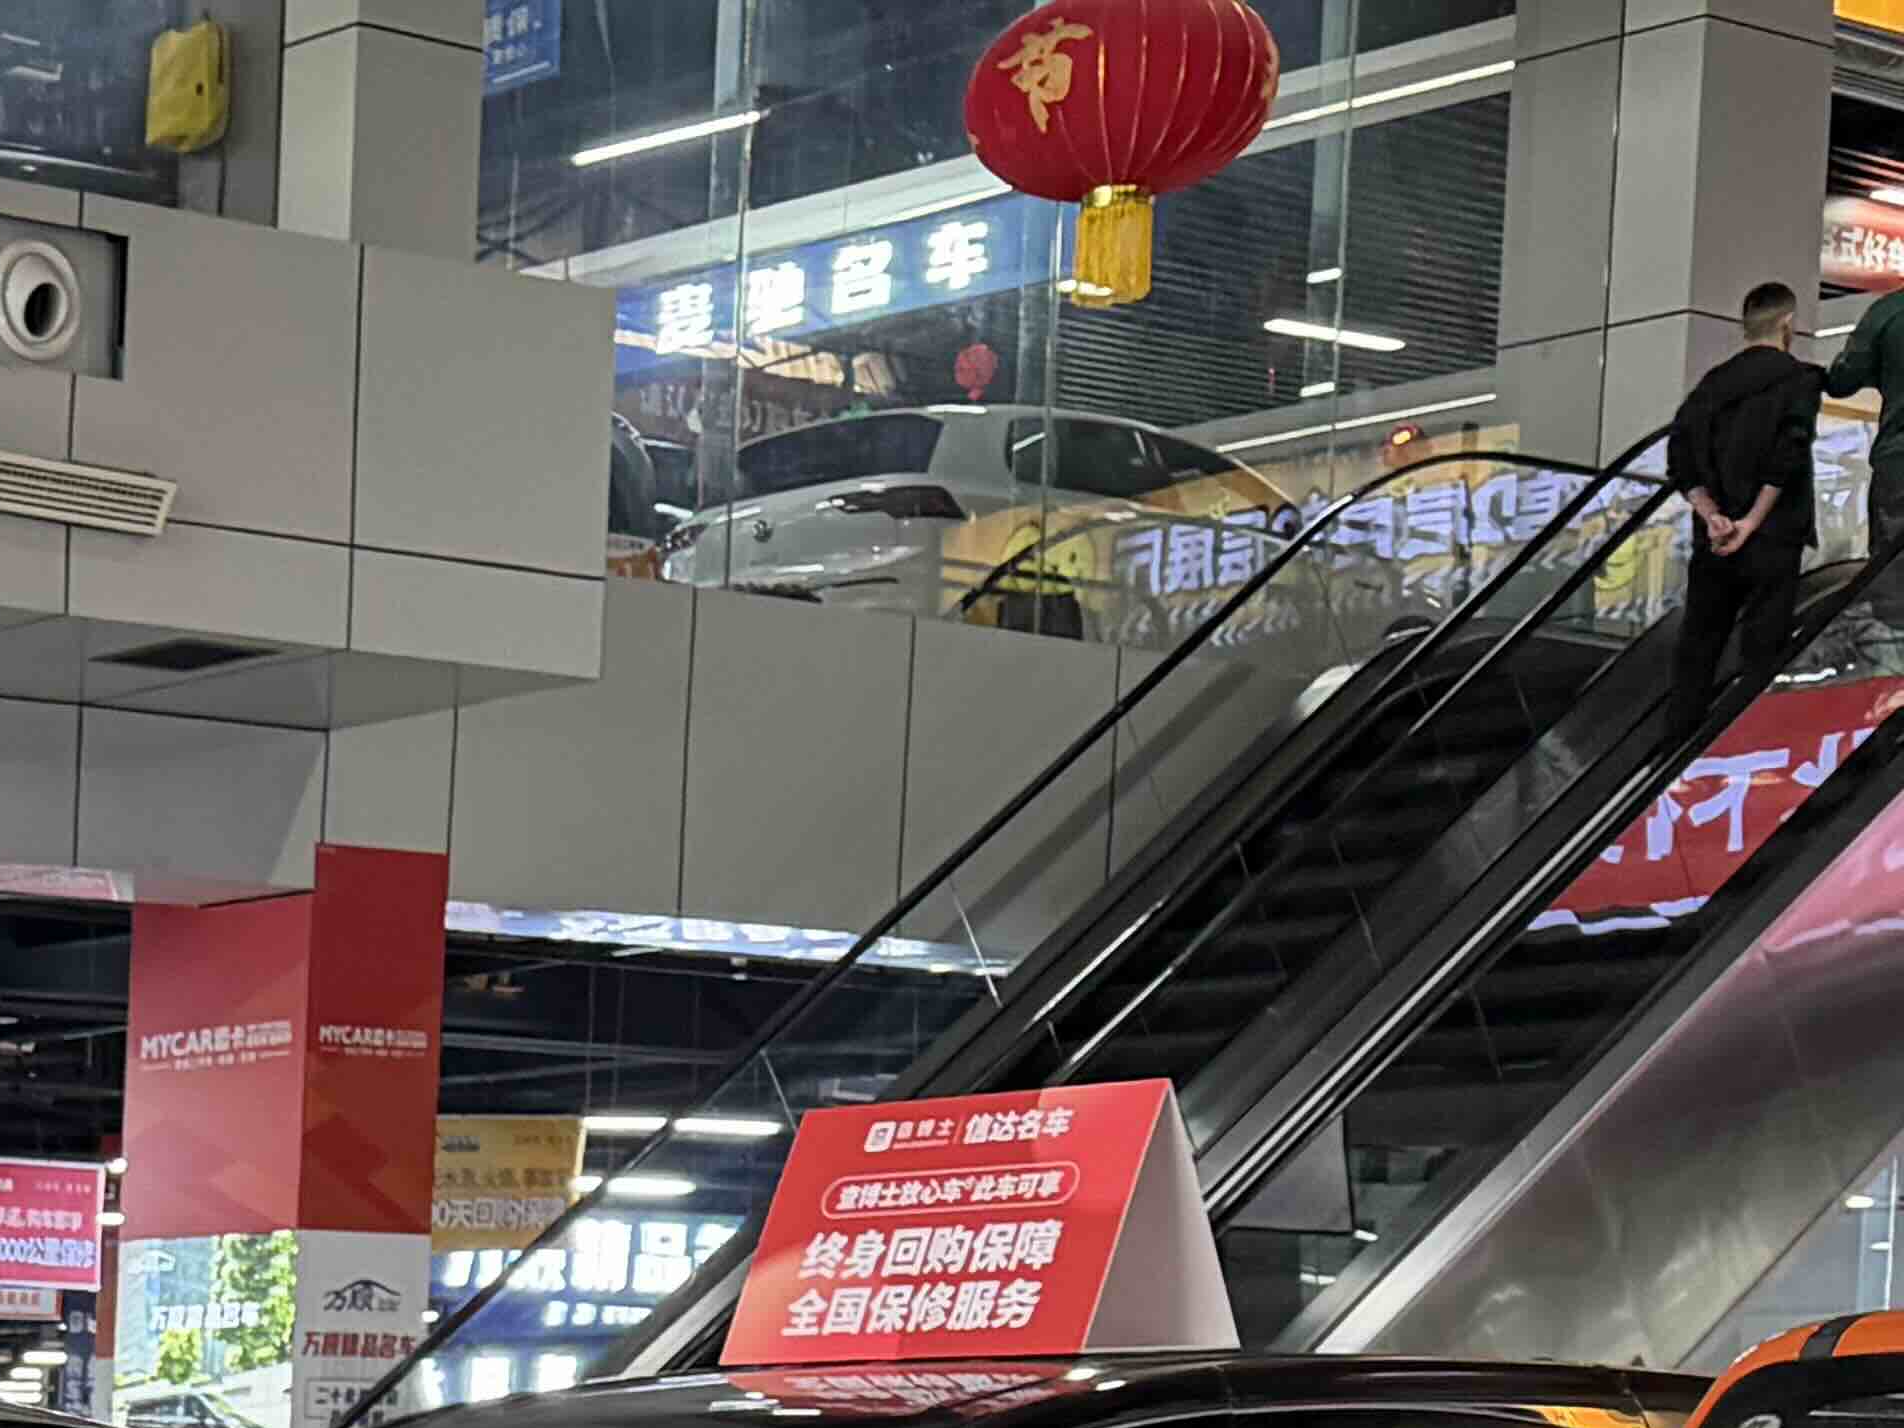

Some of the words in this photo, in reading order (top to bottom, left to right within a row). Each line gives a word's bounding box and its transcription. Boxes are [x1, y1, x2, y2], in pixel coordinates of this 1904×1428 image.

[964, 1107, 1075, 1145] 信达名车
[797, 1219, 1063, 1281] 终身回购保障
[781, 1280, 1042, 1337] 全国保修服务
